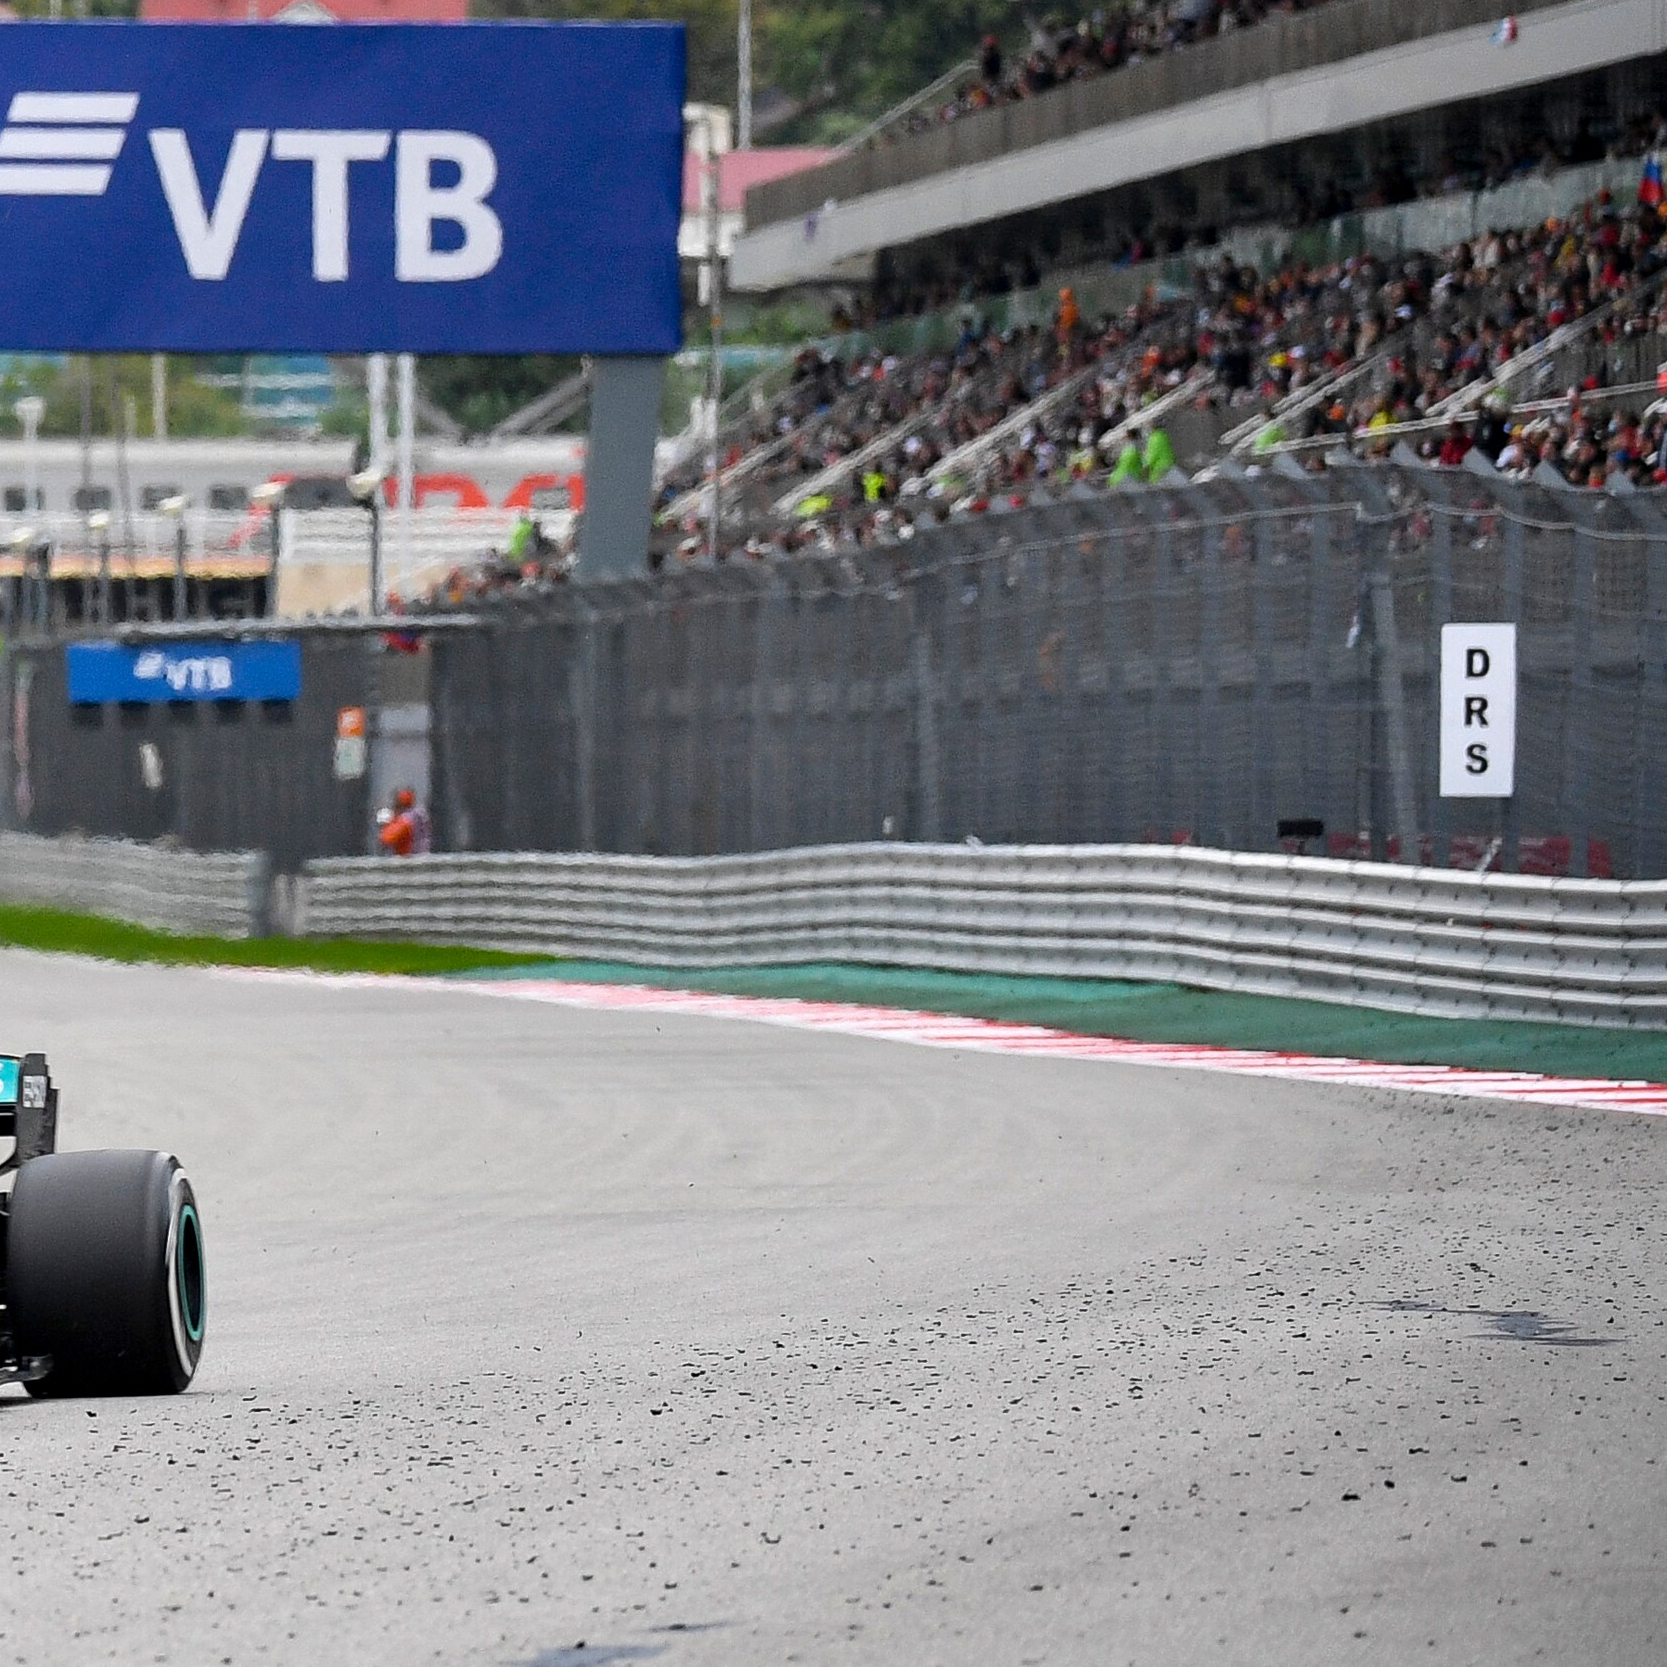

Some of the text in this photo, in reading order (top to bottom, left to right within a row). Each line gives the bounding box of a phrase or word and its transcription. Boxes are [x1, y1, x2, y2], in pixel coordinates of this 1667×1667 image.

[148, 129, 504, 283] VTB
[166, 656, 232, 690] VTB
[1464, 647, 1491, 775] DRS
